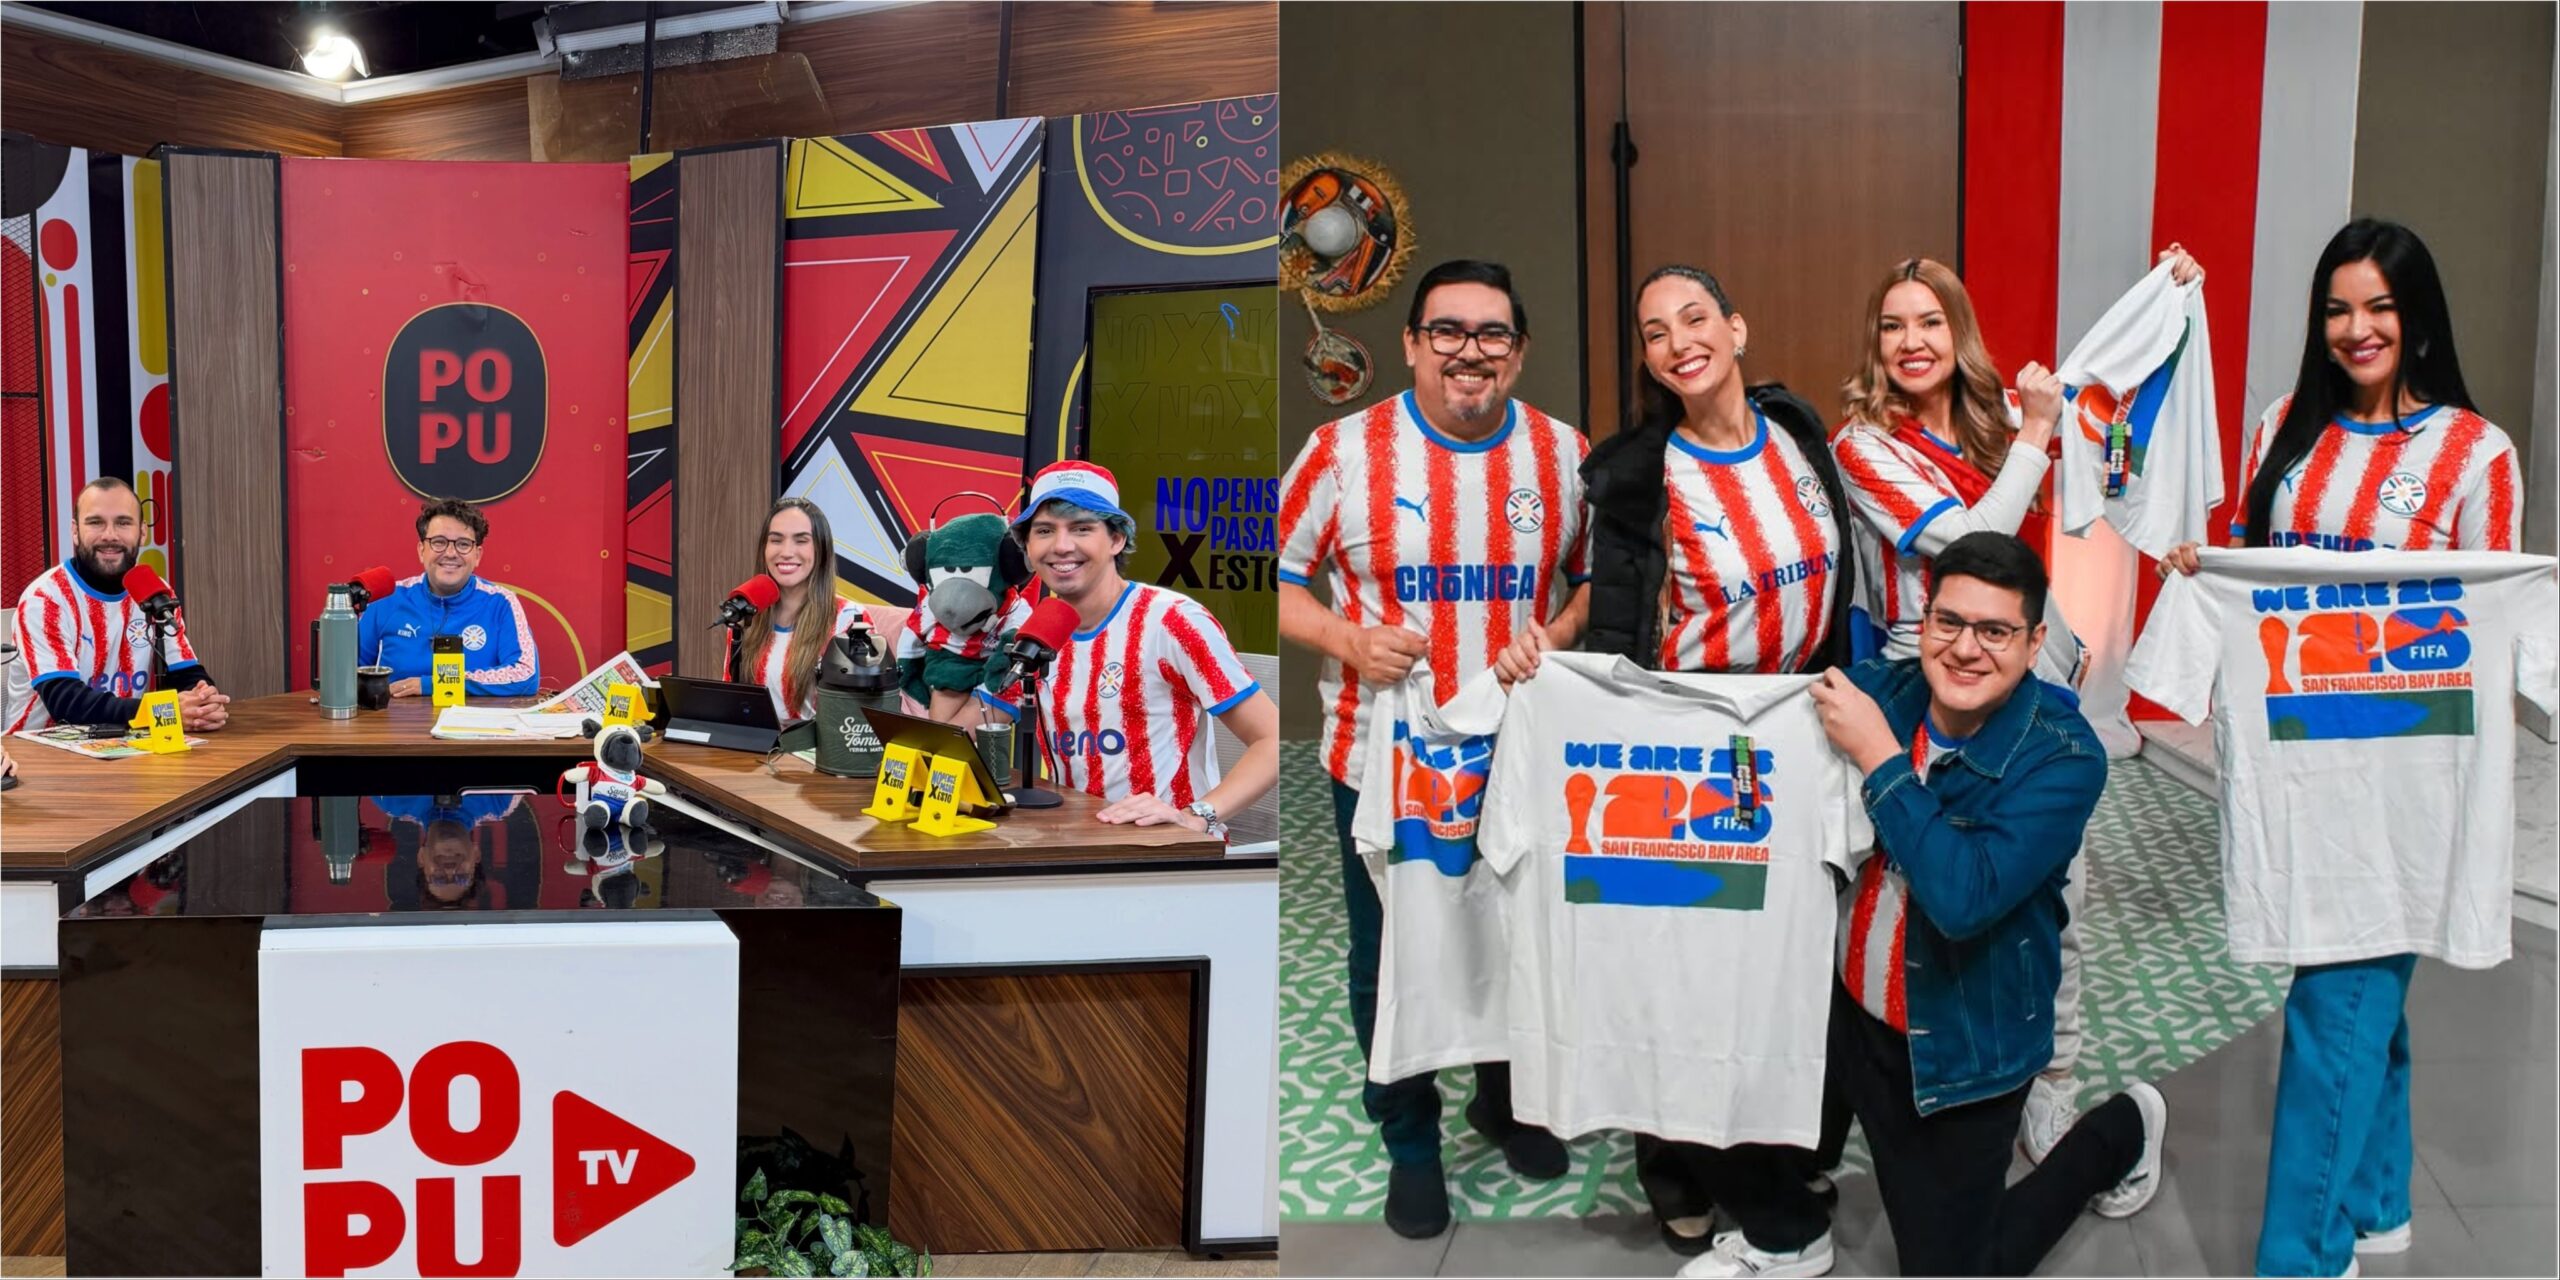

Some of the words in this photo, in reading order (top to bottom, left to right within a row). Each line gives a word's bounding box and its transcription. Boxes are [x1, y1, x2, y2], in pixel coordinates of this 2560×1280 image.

[419, 348, 512, 403] PO
[419, 411, 512, 465] PU
[1155, 477, 1209, 532] NO
[1210, 516, 1277, 552] PASA
[1155, 533, 1207, 589] X
[1720, 579, 1758, 605] LA
[1759, 550, 1837, 592] TRIBUN
[2252, 586, 2310, 613] WE
[2315, 582, 2391, 609] ARE
[2397, 577, 2464, 604] 26
[2410, 645, 2448, 660] FIFA
[2301, 677, 2330, 693] SAN
[2331, 675, 2407, 692] FRANCISCO
[2408, 673, 2437, 689] BAY
[2437, 672, 2473, 688] AREA
[1564, 742, 1623, 769] WE
[1628, 745, 1704, 773] ARE
[882, 771, 891, 786] X
[928, 783, 938, 799] X
[1601, 840, 1630, 856] SAN
[1632, 842, 1707, 858] FRANCISCO
[1708, 845, 1736, 860] BAY
[1735, 847, 1770, 861] AREA
[301, 1040, 521, 1170] PO
[578, 1148, 640, 1186] TV
[303, 1174, 521, 1278] PU
